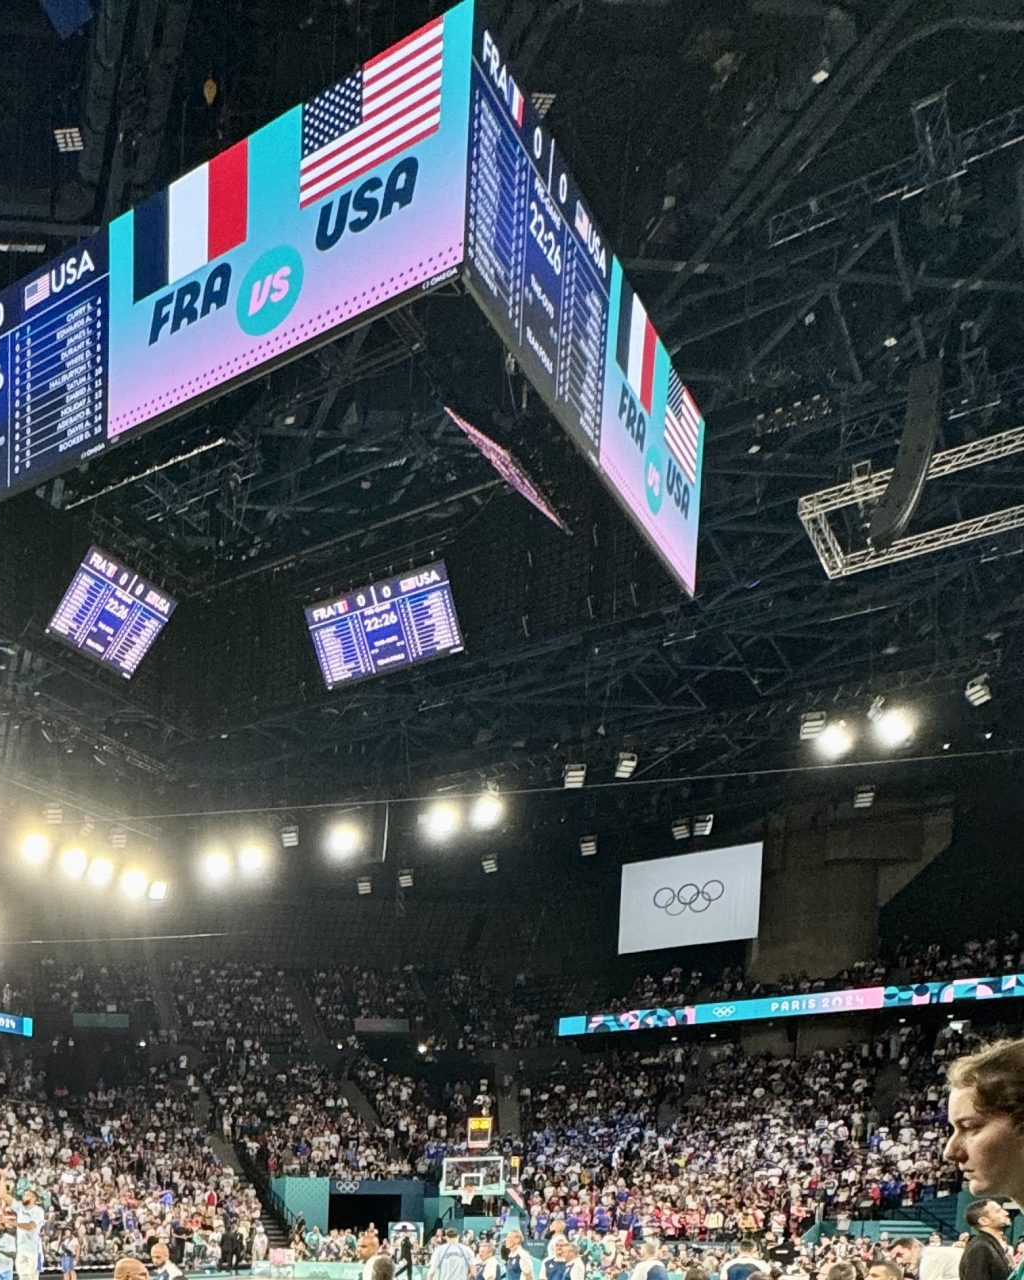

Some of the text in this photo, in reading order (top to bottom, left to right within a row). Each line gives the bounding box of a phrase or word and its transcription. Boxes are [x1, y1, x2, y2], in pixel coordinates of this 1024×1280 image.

[483, 30, 510, 102] FRA
[533, 126, 542, 160] 0
[559, 173, 567, 203] 0
[588, 223, 607, 278] USA
[315, 156, 419, 252] USA
[529, 202, 561, 276] 22:26
[52, 250, 95, 293] USA
[248, 266, 291, 317] VS
[148, 263, 231, 347] FRA
[618, 382, 646, 453] FRA
[666, 457, 690, 520] USA
[357, 594, 365, 607] 0
[382, 586, 391, 598] 0
[415, 570, 441, 587] USA
[364, 611, 398, 632] 22:26
[822, 994, 865, 1008] 2024
